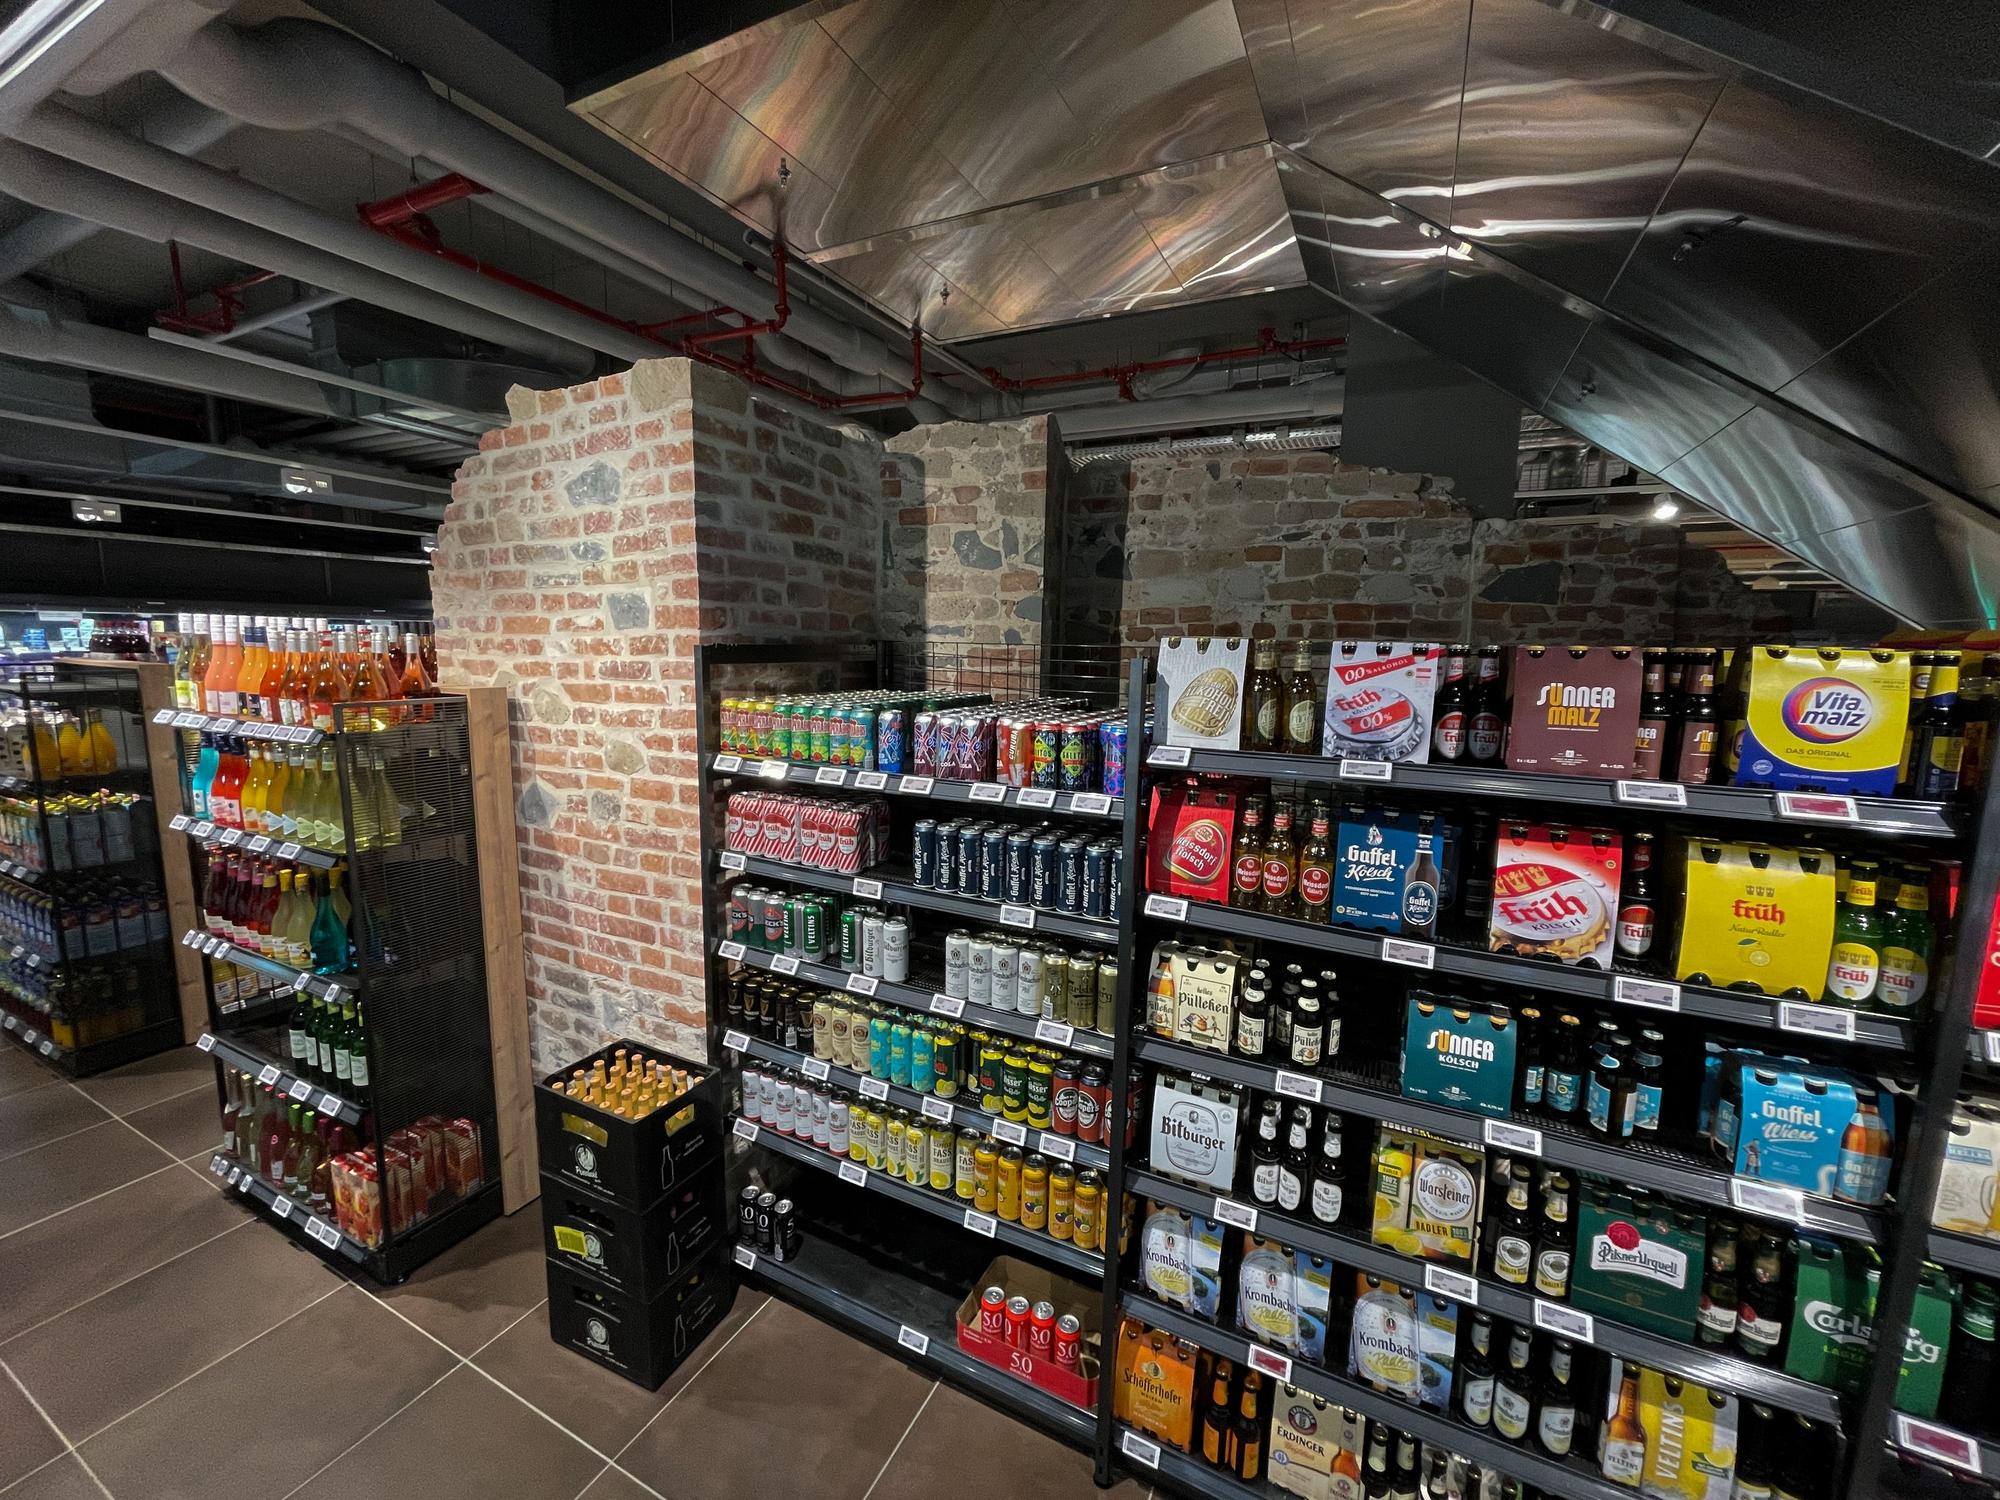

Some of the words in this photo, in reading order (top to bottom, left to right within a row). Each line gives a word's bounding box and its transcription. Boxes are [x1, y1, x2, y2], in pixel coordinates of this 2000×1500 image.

[1373, 658, 1409, 673] ALKOHOL
[1185, 684, 1234, 711] ALKOHOL
[1536, 682, 1616, 709] SÜNNER
[1813, 690, 1861, 712] Vita
[1199, 694, 1231, 722] FREI
[1547, 706, 1601, 728] MALZ
[1797, 708, 1866, 727] malz
[1008, 729, 1019, 760] CURUBA
[1785, 747, 1805, 756] DAS
[1806, 748, 1853, 759] ORIGINAL
[1347, 844, 1397, 867] Gaffel
[940, 862, 950, 884] Gaffel
[1344, 863, 1396, 882] Kölsch
[1010, 874, 1020, 897] Gaffel
[1033, 878, 1043, 901] Gaffel
[1066, 882, 1076, 905] Gaffel
[1409, 896, 1431, 907] Gaffel
[807, 915, 815, 944] VELTINS
[1531, 918, 1582, 932] KÖLSCH
[1178, 991, 1229, 1015] Pülleken
[1426, 1029, 1495, 1062] SÜNNER
[1438, 1054, 1479, 1069] KÖLSCH
[1761, 1099, 1823, 1128] Gaffel
[1160, 1115, 1226, 1151] Bitburger
[933, 1147, 952, 1157] FASS
[1419, 1178, 1471, 1206] Warsteiner
[1414, 1220, 1449, 1237] RADLER
[1597, 1241, 1637, 1264] Pilsner
[1637, 1250, 1680, 1276] Urquell
[982, 1311, 1003, 1329] 5.0
[1030, 1325, 1051, 1345] 5.0
[1803, 1300, 1942, 1364] Carlsrg
[1056, 1341, 1078, 1359] 5.0
[1009, 1351, 1033, 1374] 5.0
[1123, 1367, 1184, 1406] Schöfferhofer
[1277, 1426, 1326, 1457] ERDINGER
[1655, 1401, 1686, 1480] VELTINS
